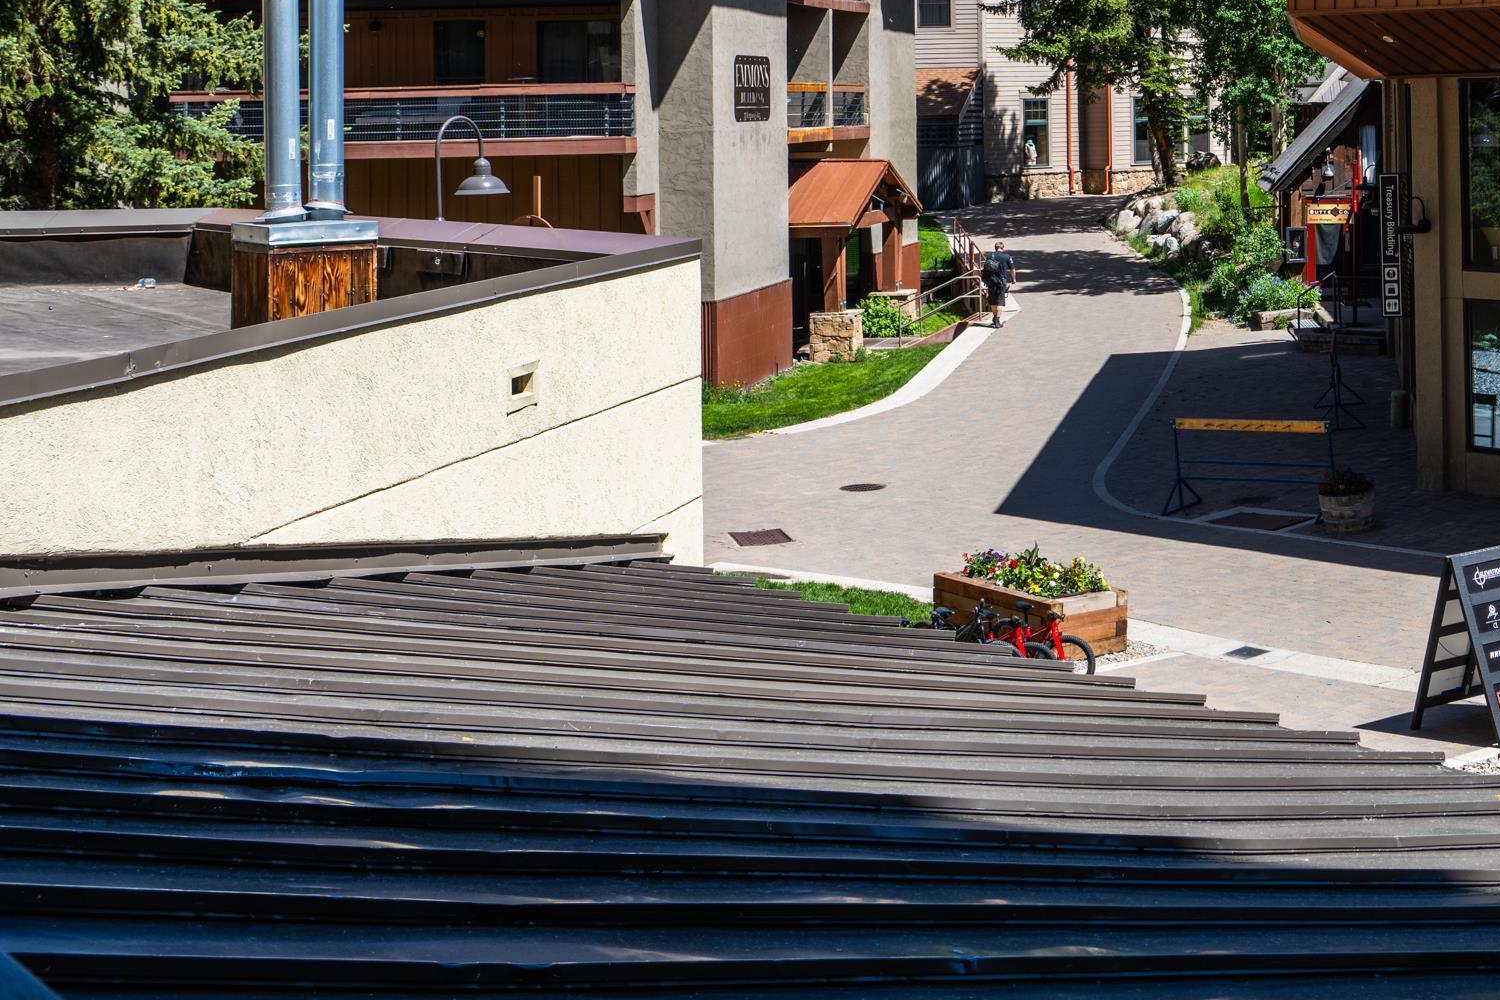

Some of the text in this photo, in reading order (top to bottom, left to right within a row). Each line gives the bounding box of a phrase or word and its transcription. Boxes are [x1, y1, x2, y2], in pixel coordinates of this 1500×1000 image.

[736, 64, 769, 88] EMMONS
[741, 92, 765, 103] BUILDING
[1385, 184, 1396, 256] Treasury Building
